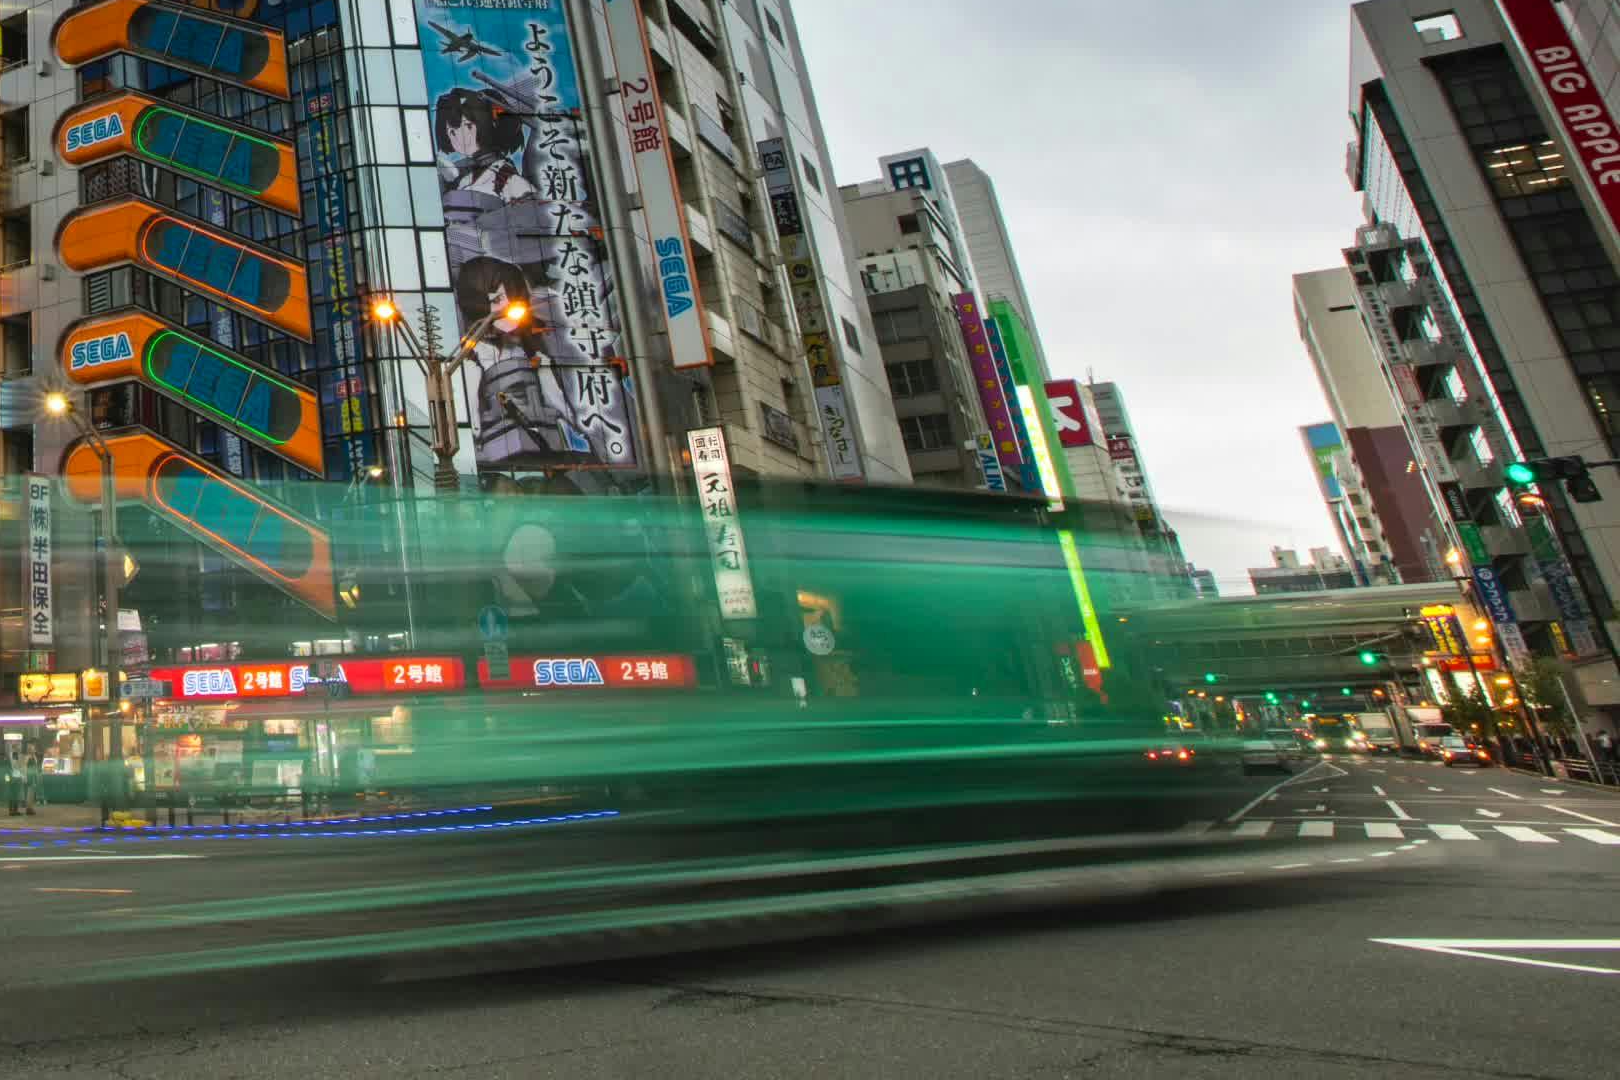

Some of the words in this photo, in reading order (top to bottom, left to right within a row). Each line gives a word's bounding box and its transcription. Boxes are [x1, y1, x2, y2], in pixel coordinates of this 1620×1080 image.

[66, 113, 124, 152] SEGA
[622, 77, 661, 154] 2号館
[1534, 45, 1587, 94] BIG
[1564, 104, 1620, 187] APPLE
[655, 237, 692, 320] SEGA
[70, 332, 133, 369] SEGA
[30, 484, 48, 500] 8F
[182, 667, 238, 696] SEGA
[243, 670, 281, 690] 2号館
[393, 663, 442, 685] 2号館
[534, 658, 604, 686] SEGA
[620, 660, 668, 682] 2号館
